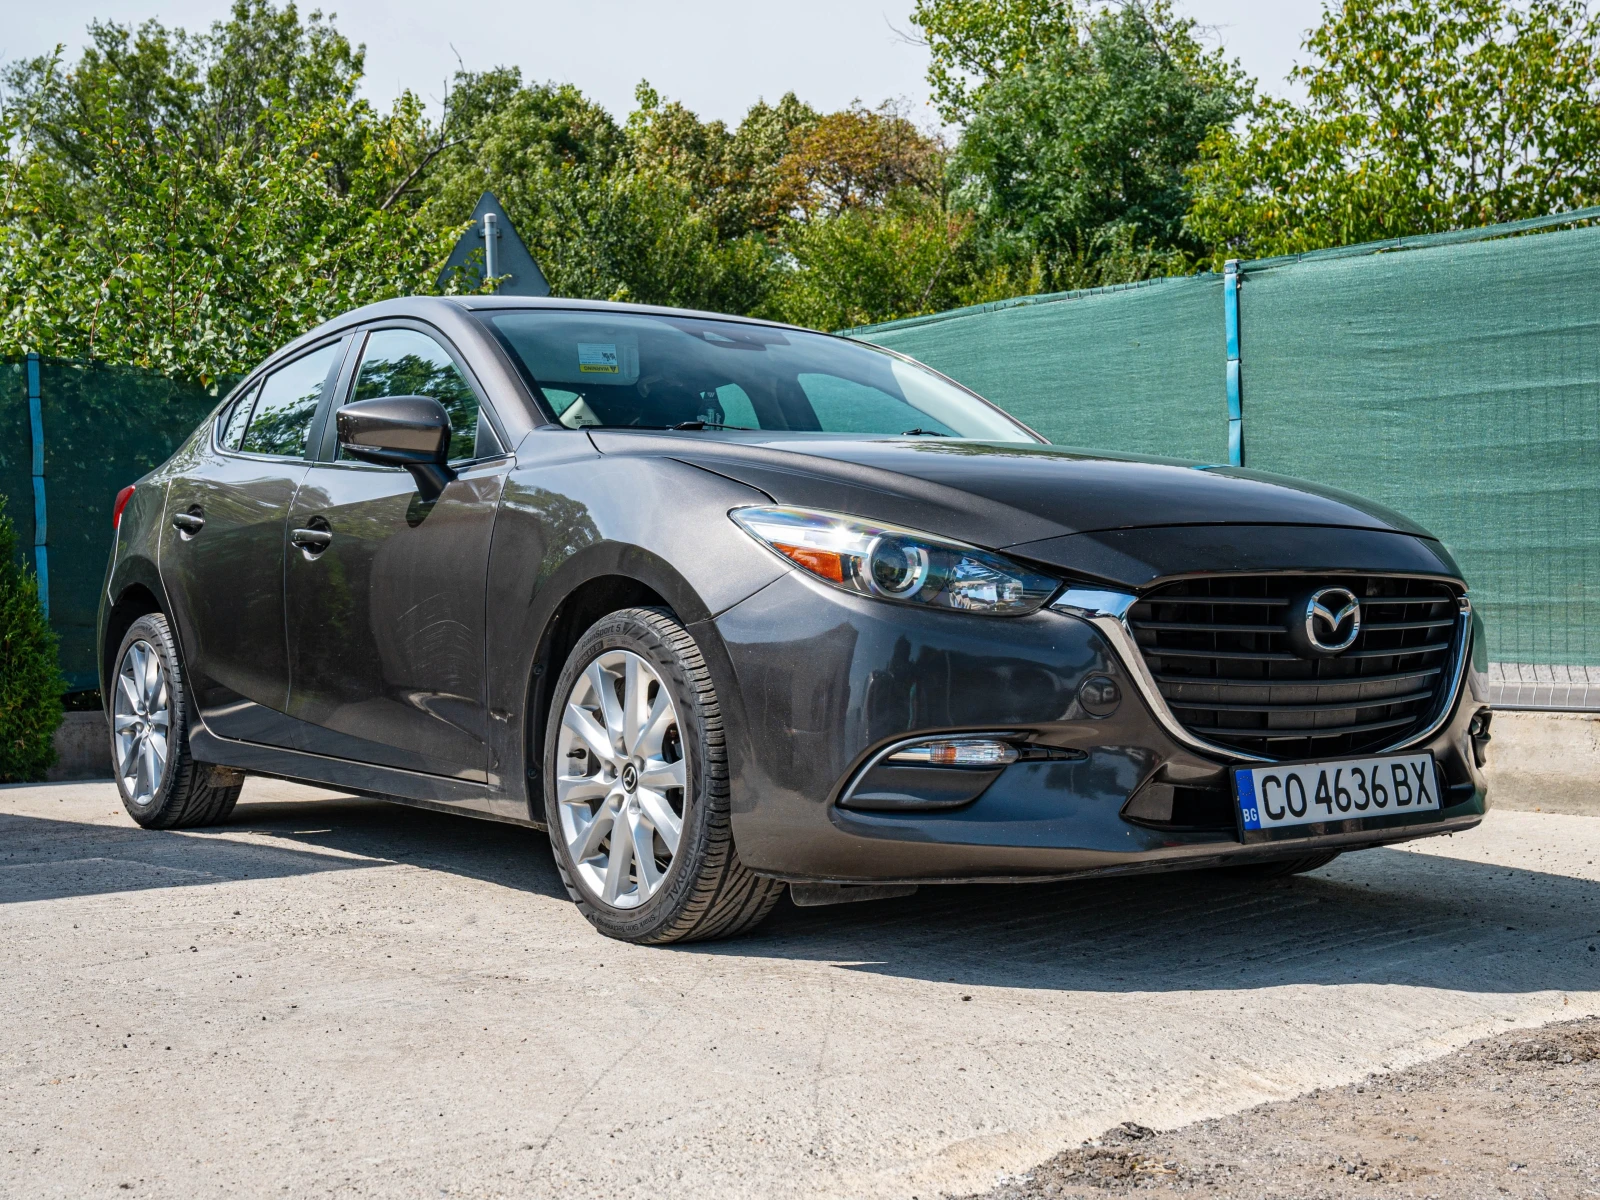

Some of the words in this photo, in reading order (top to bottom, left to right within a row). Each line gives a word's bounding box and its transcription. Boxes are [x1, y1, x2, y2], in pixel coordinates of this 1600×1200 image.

[581, 626, 614, 650] RainSport
[616, 624, 621, 632] 5
[1261, 773, 1307, 821] CO
[1314, 765, 1388, 815] 4636
[1390, 761, 1432, 807] BX
[1243, 808, 1258, 822] BG
[640, 914, 656, 926] Shark
